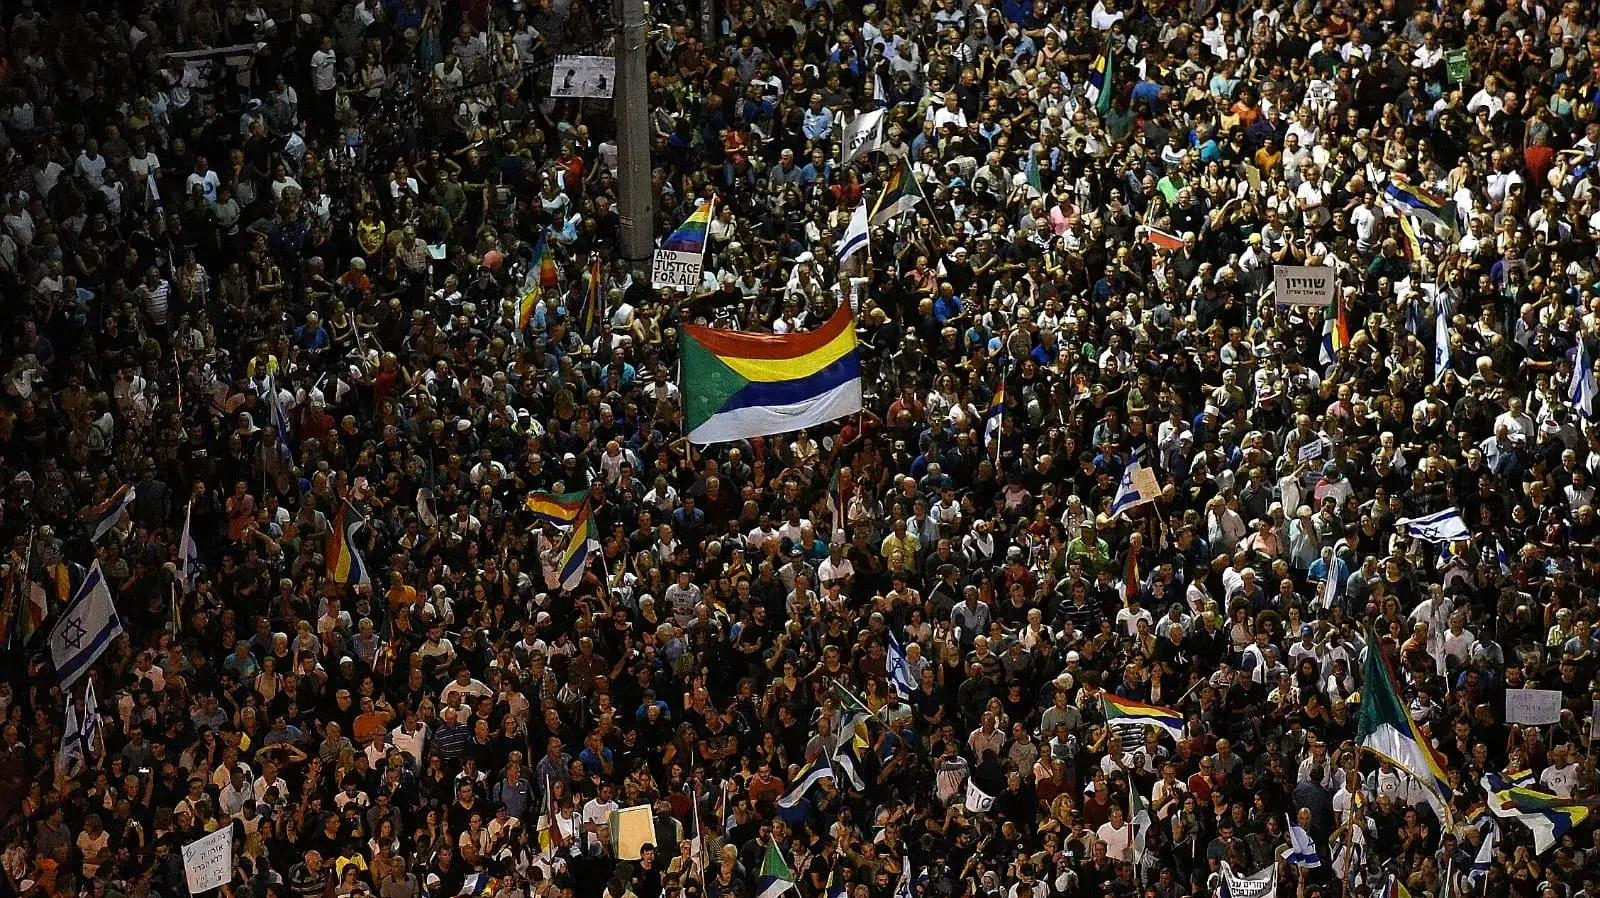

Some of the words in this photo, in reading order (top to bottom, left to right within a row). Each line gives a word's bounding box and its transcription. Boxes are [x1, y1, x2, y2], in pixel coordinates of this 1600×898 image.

[655, 250, 677, 261] AND
[654, 259, 700, 274] JUSTICE
[654, 271, 676, 283] FOR
[1285, 277, 1326, 289] שוויון
